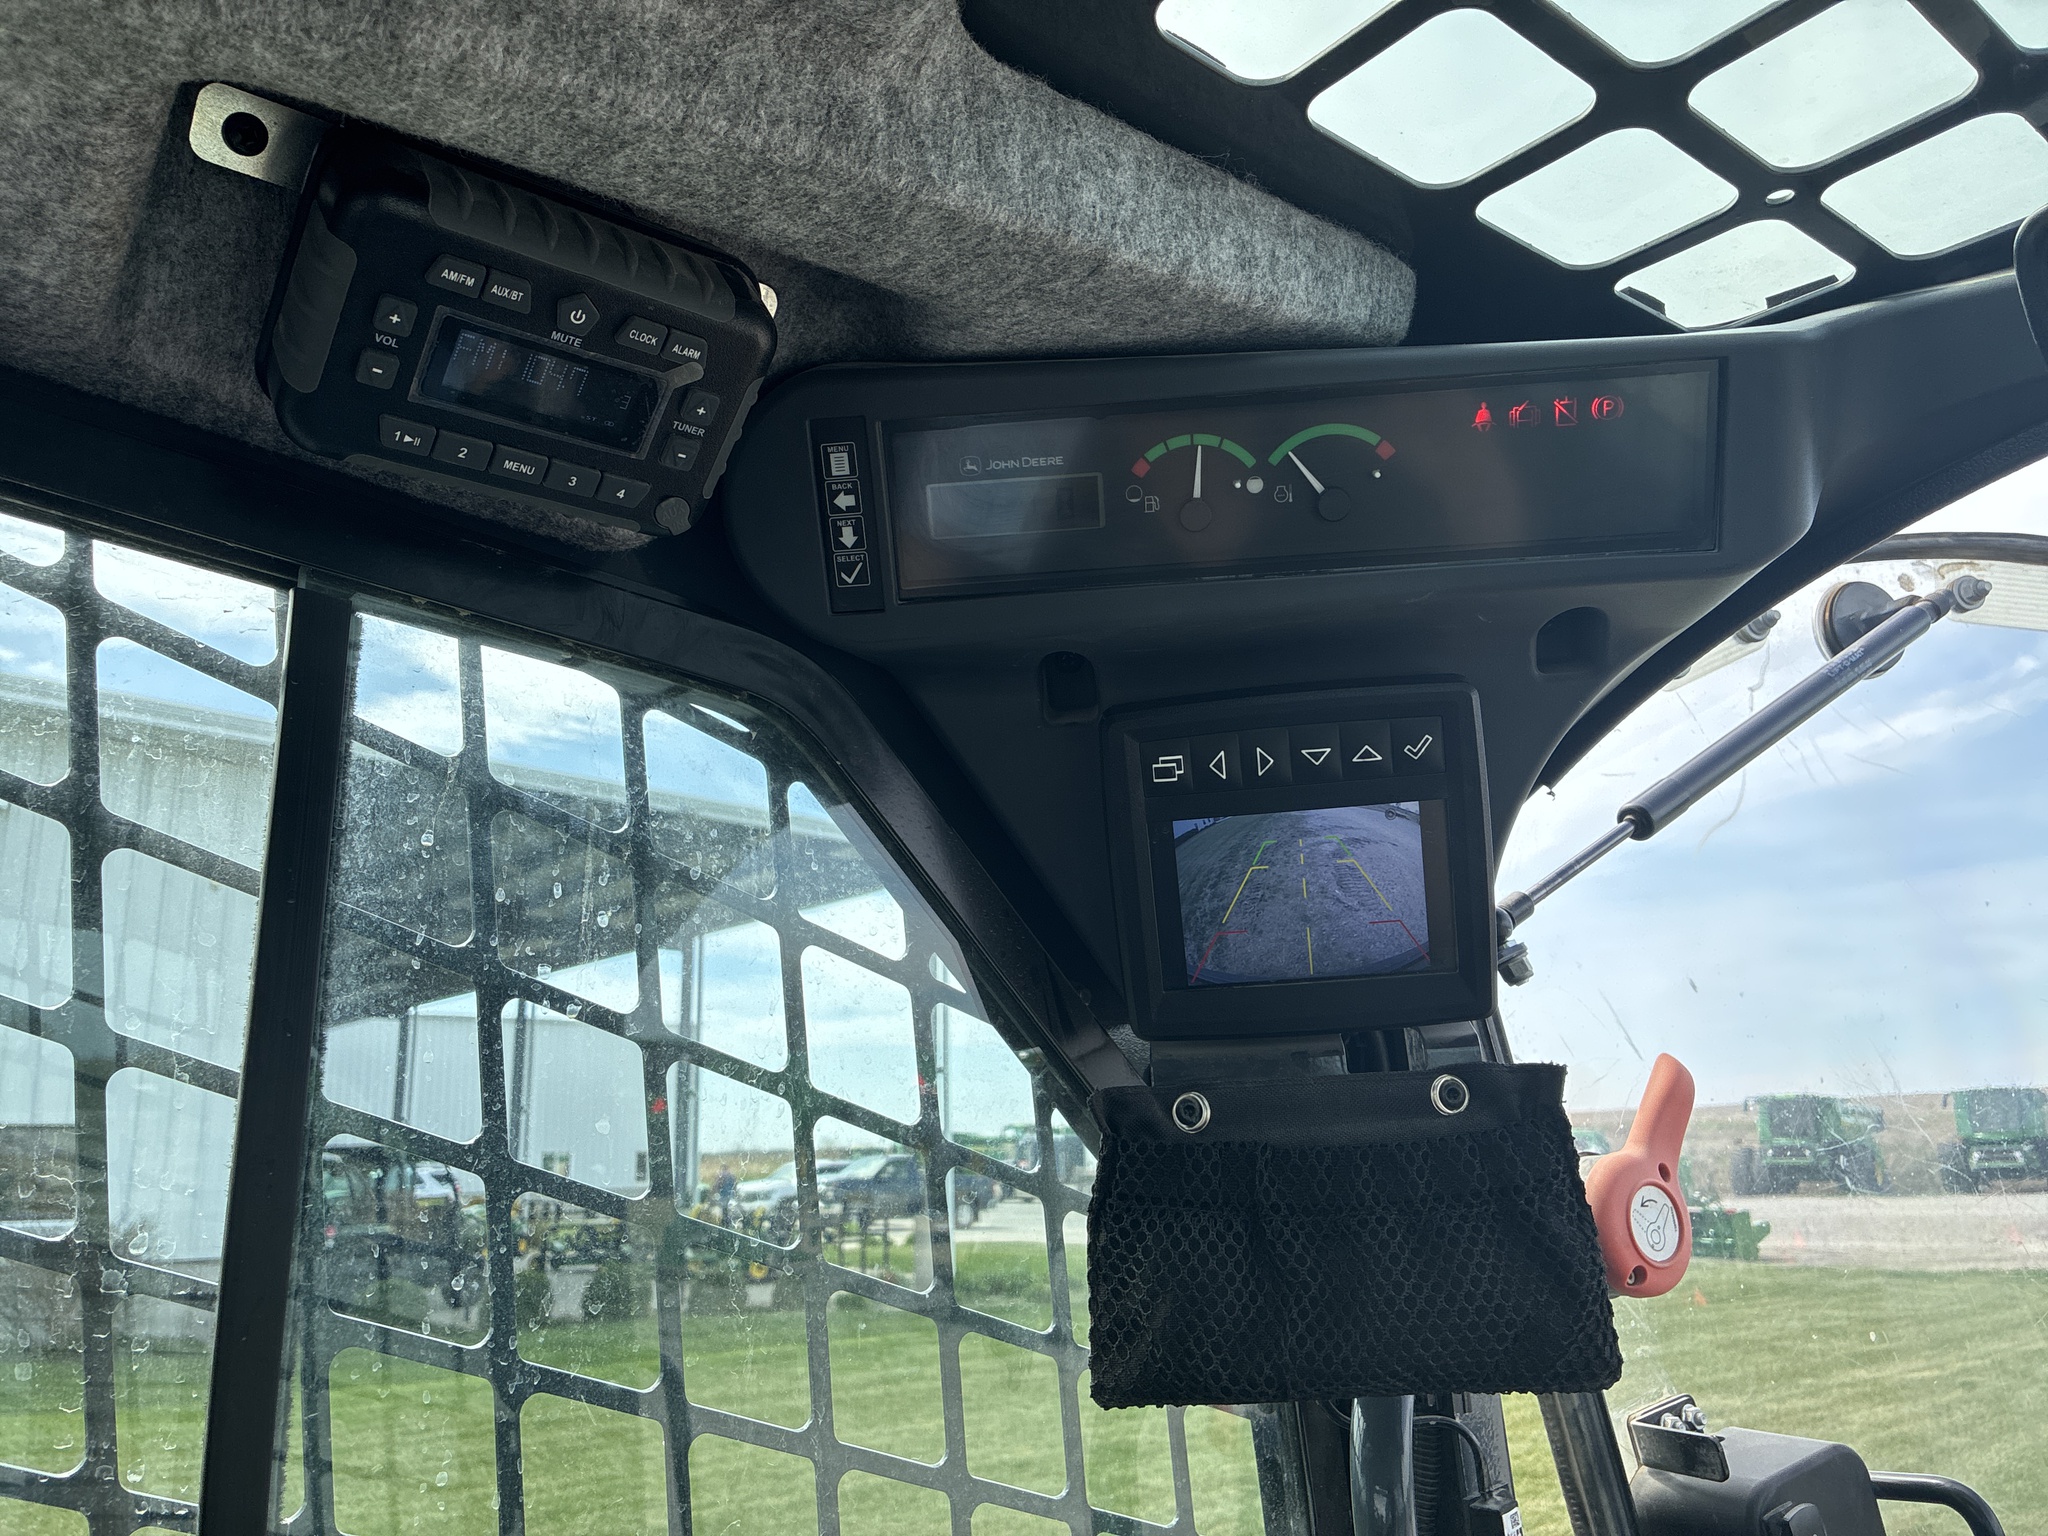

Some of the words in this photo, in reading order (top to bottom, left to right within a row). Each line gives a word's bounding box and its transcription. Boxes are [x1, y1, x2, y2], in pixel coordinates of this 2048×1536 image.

[440, 268, 475, 287] AM/FM
[490, 284, 524, 303] AUX/BT
[375, 333, 399, 349] VOL
[550, 330, 583, 348] MUTE
[629, 329, 659, 346] CLOCK
[671, 344, 702, 360] ALARM
[393, 430, 402, 442] 1
[672, 420, 706, 437] TUNER
[457, 447, 468, 459] 2
[827, 445, 849, 453] MENU
[503, 459, 536, 475] MENU
[985, 459, 1020, 471] JOHN
[1021, 456, 1064, 468] DEERE
[567, 475, 577, 487] 3
[831, 483, 853, 491] BACK
[616, 488, 626, 499] 4
[836, 554, 865, 563] SELECT
